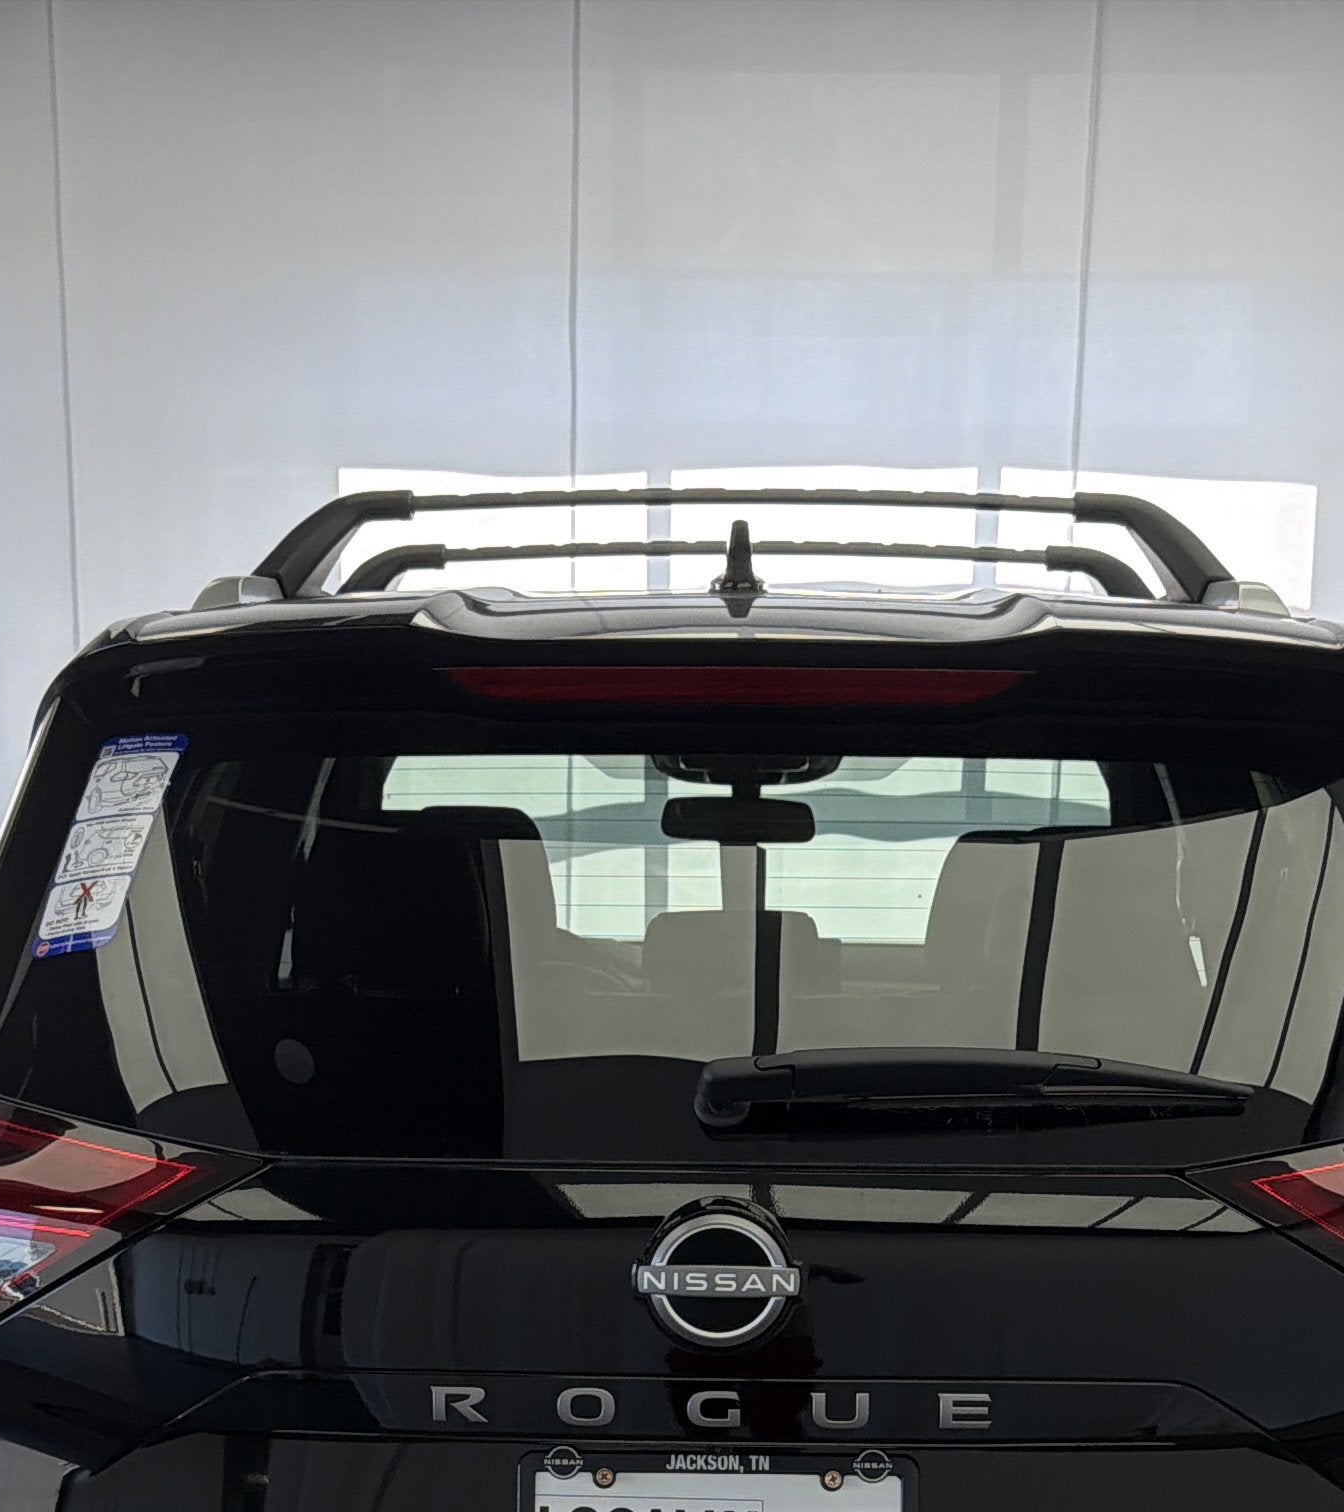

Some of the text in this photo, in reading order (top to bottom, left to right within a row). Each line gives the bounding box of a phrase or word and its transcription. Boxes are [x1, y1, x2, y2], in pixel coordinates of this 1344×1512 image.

[641, 1270, 797, 1294] NISSAN
[429, 1384, 993, 1430] ROGUE
[665, 1454, 771, 1473] JACKSON, TN
